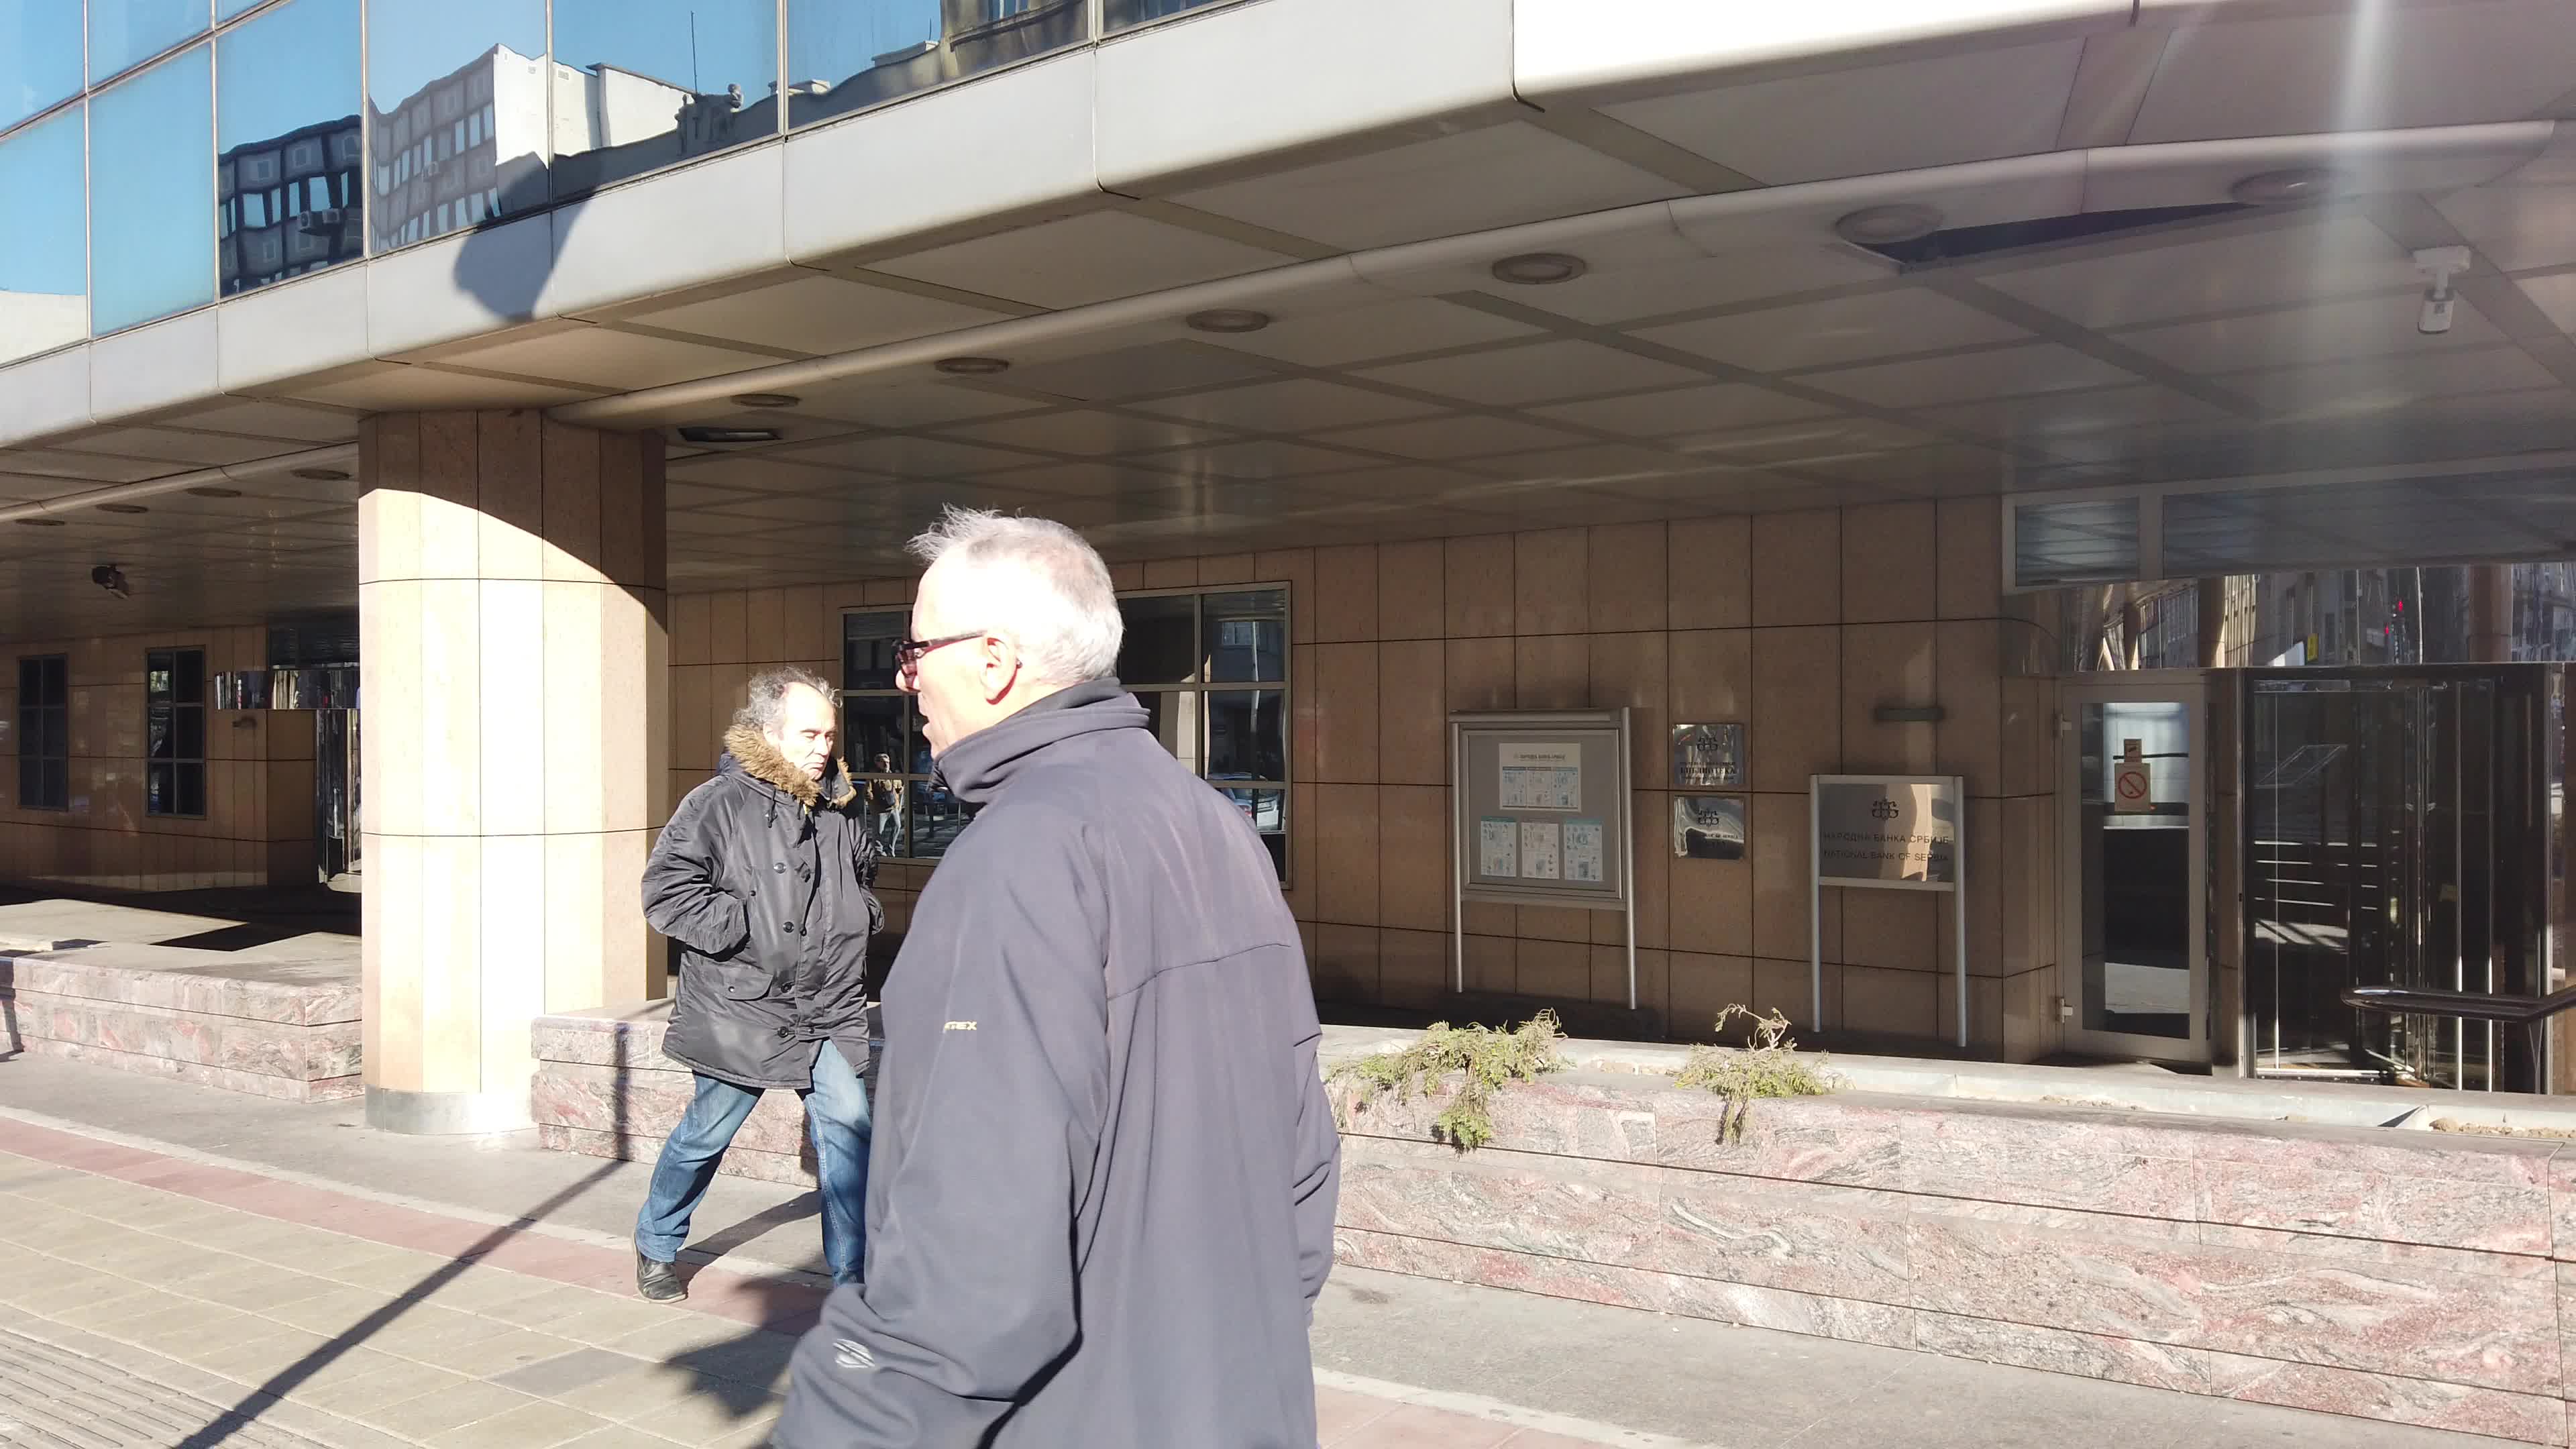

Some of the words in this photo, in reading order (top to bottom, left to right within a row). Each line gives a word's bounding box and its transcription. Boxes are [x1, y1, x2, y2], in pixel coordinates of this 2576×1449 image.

[1874, 834, 1906, 843] БАНКА
[1910, 835, 1949, 844] СРБИЈЕ
[1824, 850, 1868, 859] NATIONAL
